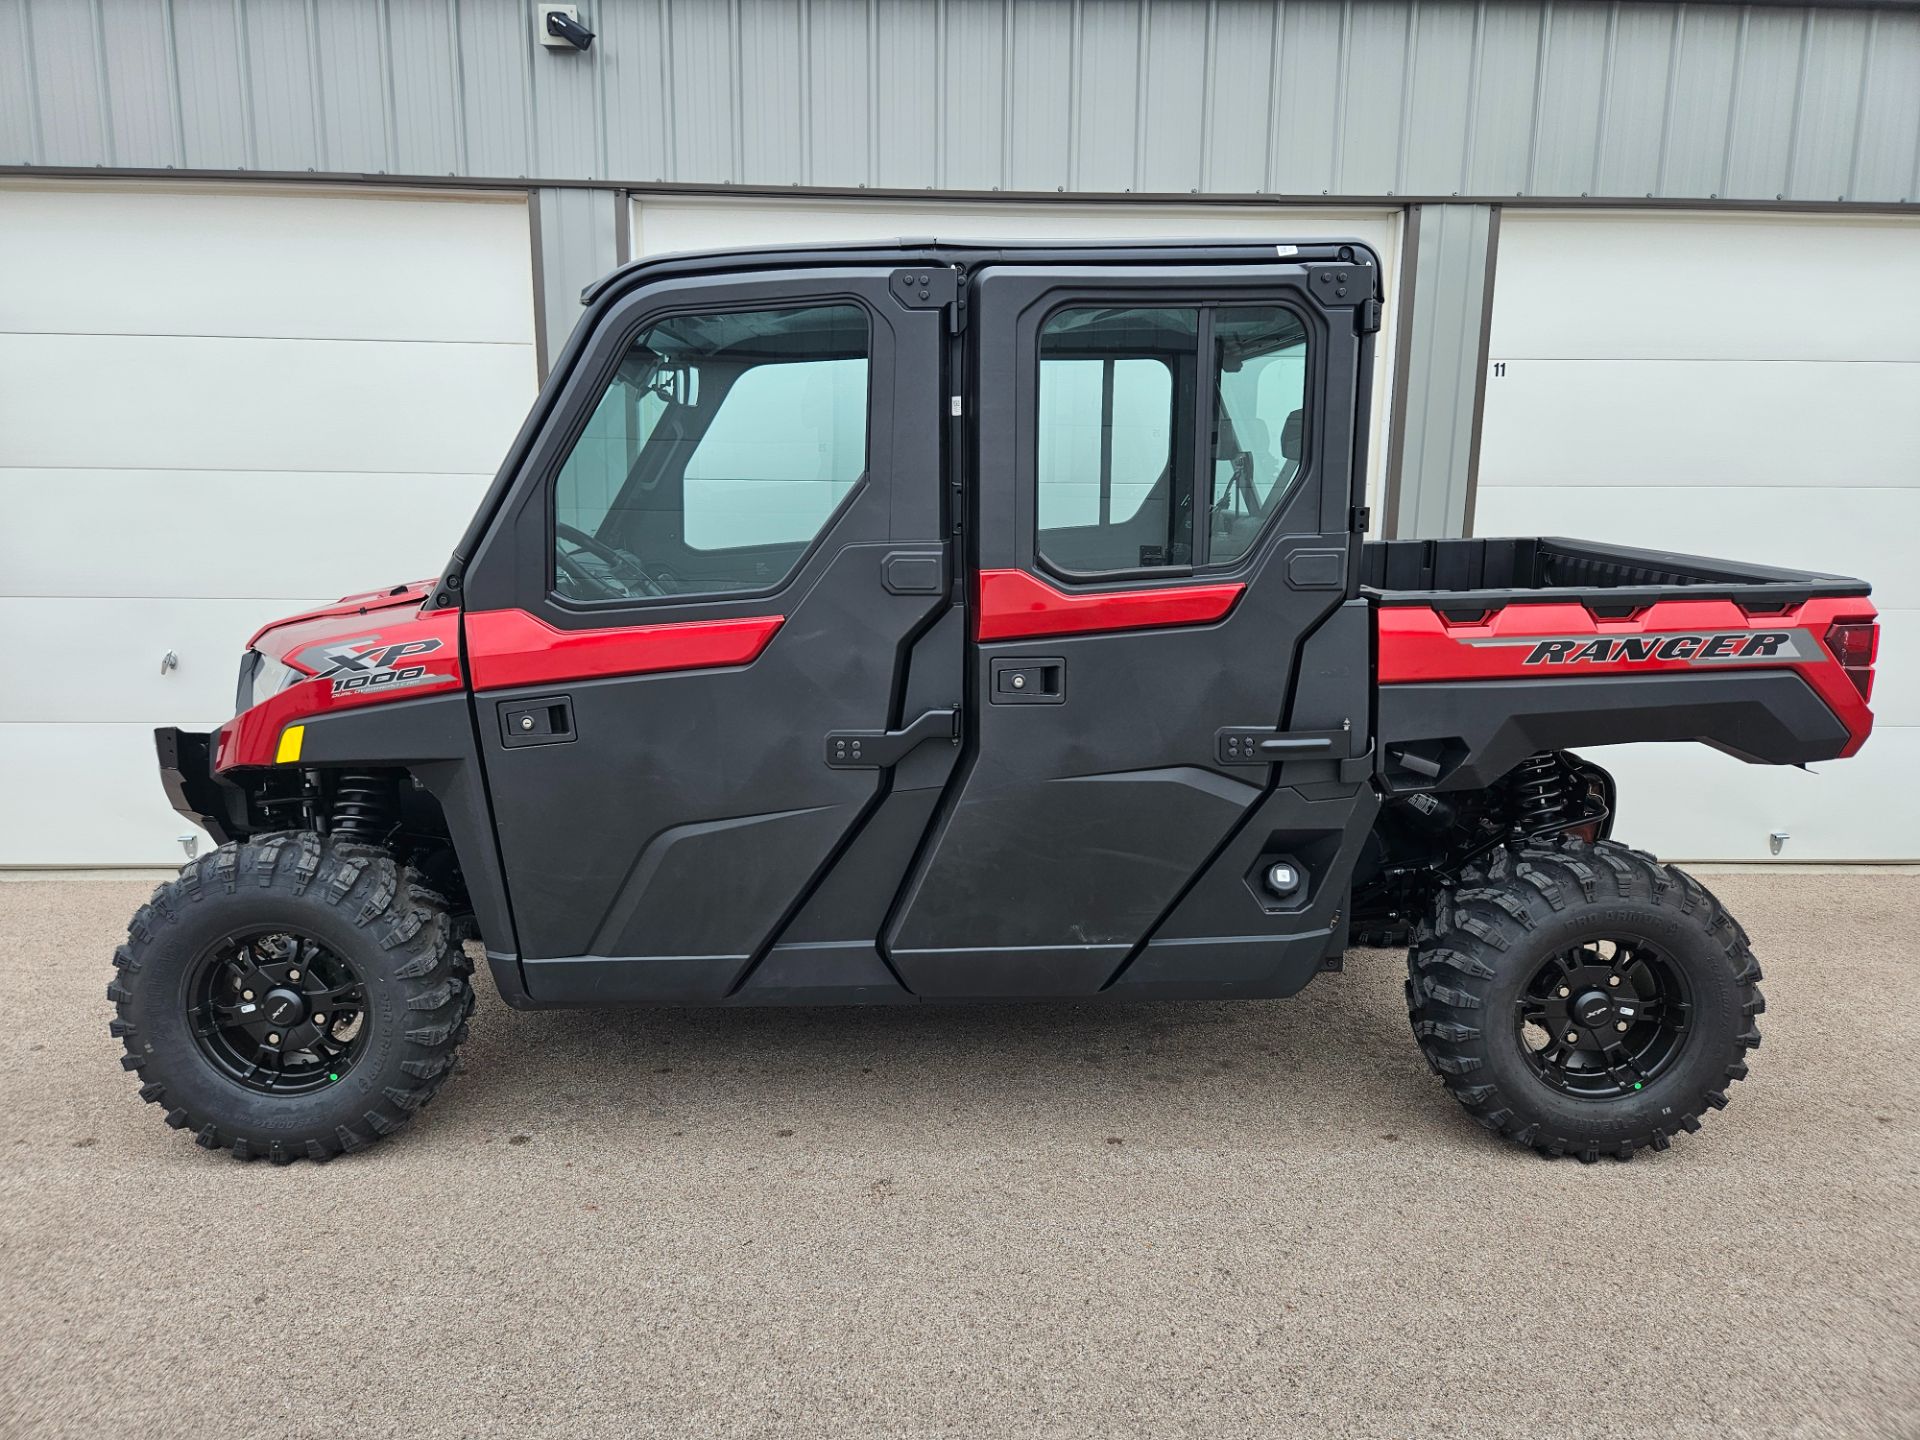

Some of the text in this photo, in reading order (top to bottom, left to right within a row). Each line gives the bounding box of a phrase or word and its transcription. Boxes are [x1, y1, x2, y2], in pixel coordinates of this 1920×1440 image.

[1494, 362, 1506, 377] 11
[314, 638, 443, 679] XP
[1524, 634, 1790, 665] RANGER
[331, 666, 425, 693] 1000
